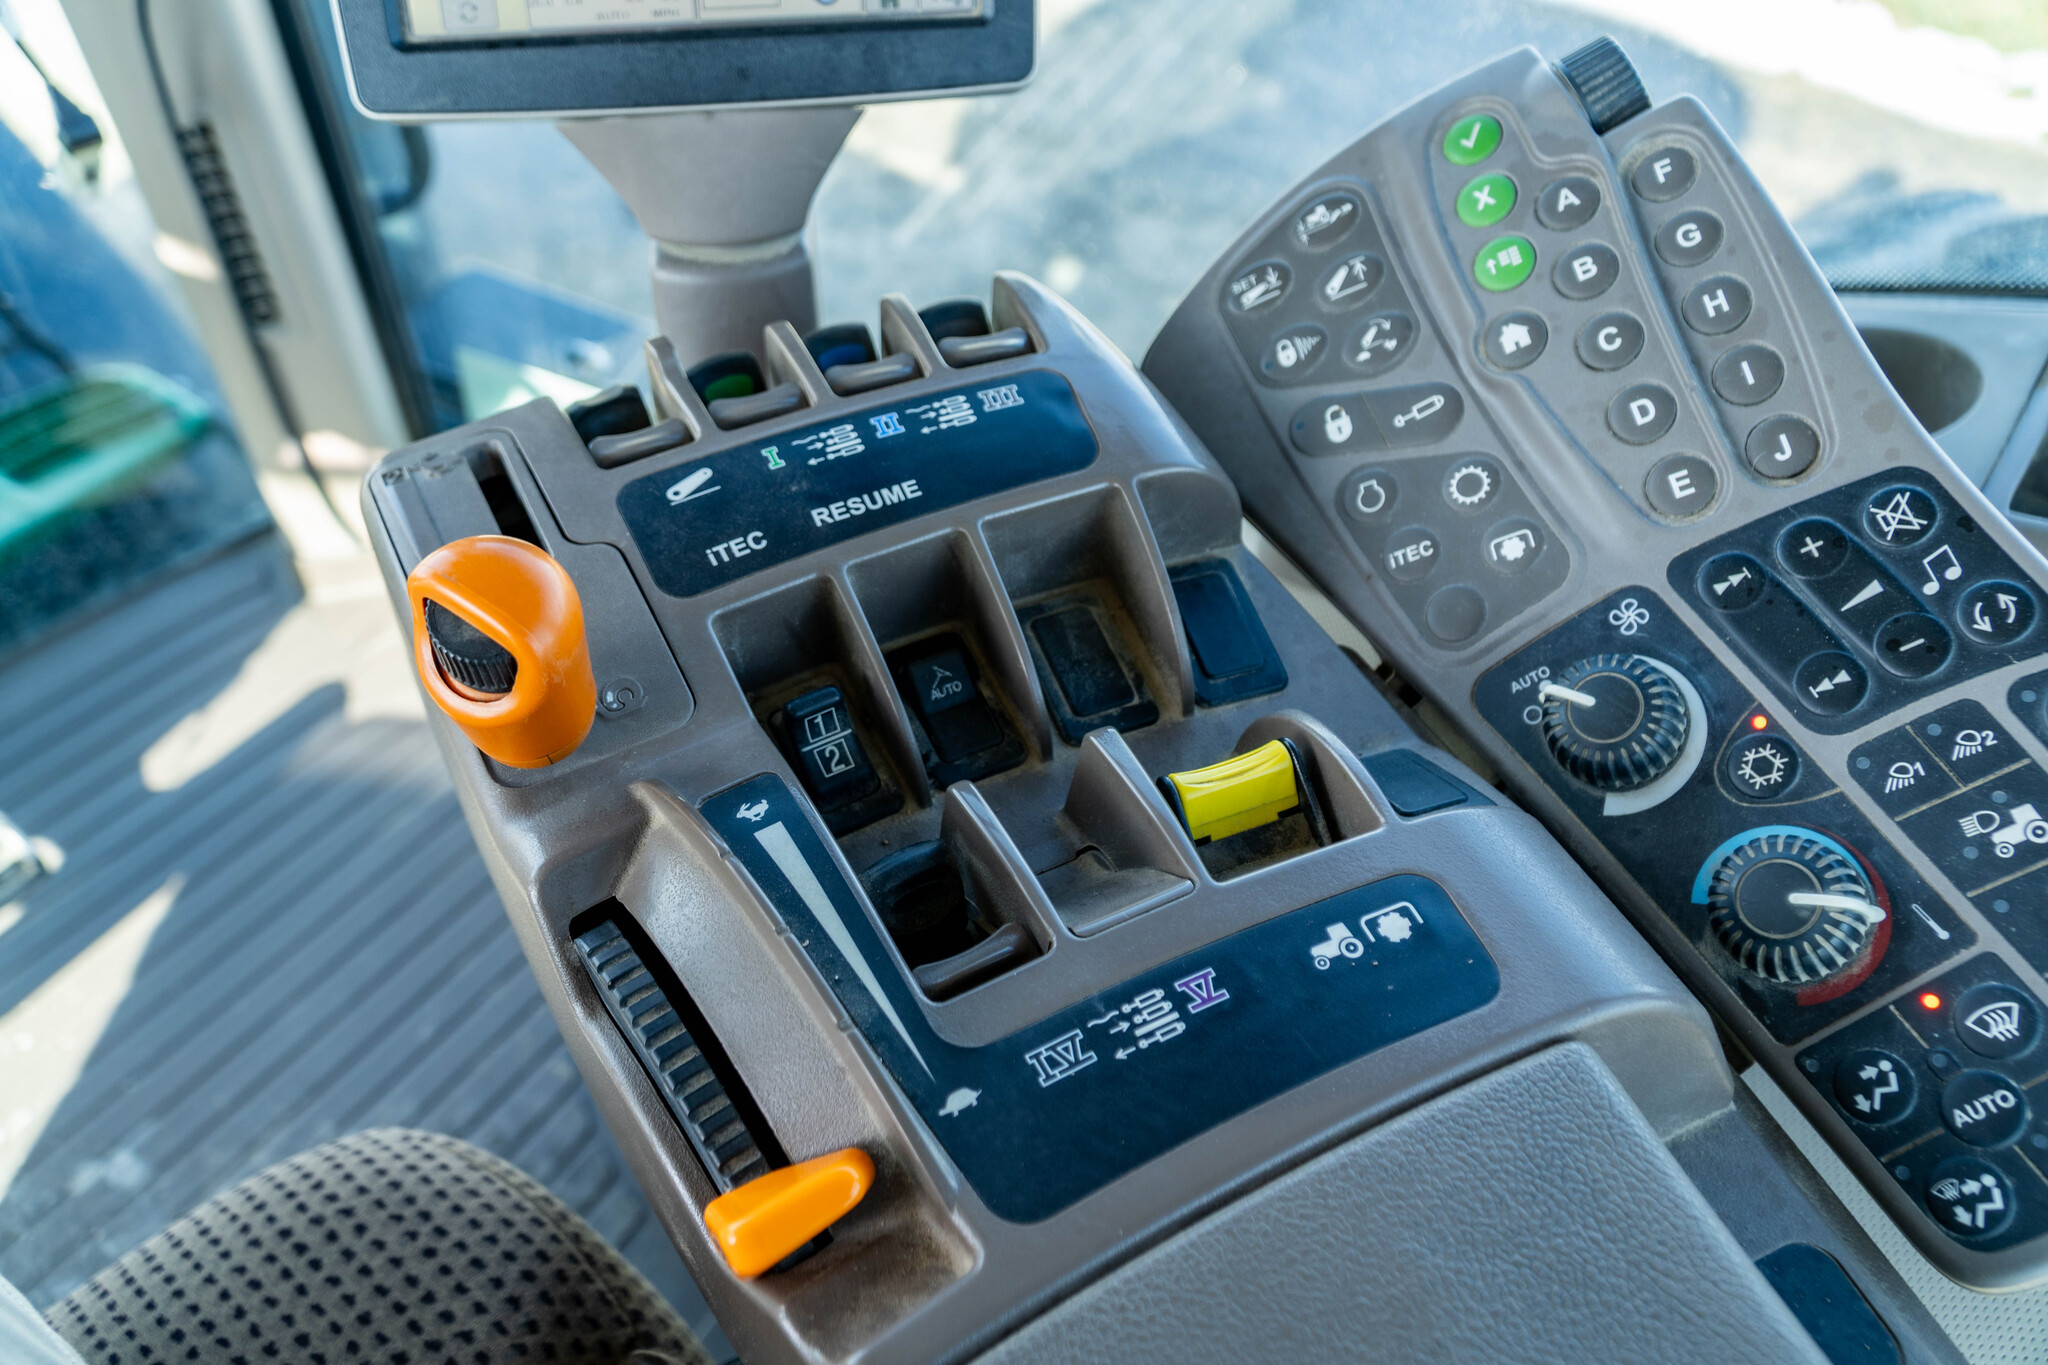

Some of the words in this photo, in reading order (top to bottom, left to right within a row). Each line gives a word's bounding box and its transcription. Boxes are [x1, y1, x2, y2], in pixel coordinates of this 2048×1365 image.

[1653, 157, 1673, 184] F
[1556, 186, 1582, 213] A
[1675, 222, 1704, 248] G
[1572, 255, 1599, 283] B
[1231, 273, 1259, 296] SET
[1702, 288, 1731, 318] H
[1596, 326, 1623, 353] C
[1740, 360, 1756, 387] I
[1629, 398, 1657, 426] D
[1773, 433, 1794, 462] J
[1667, 468, 1697, 500] E
[705, 530, 769, 568] iTEC
[810, 478, 924, 529] RESUME
[1388, 540, 1435, 570] iTEC
[930, 680, 963, 701] AUTO
[1511, 665, 1551, 695] AUTO
[1981, 730, 1998, 747] 2
[824, 744, 846, 773] 2
[1913, 761, 1926, 777] 1
[1952, 1088, 2017, 1129] AUTO
